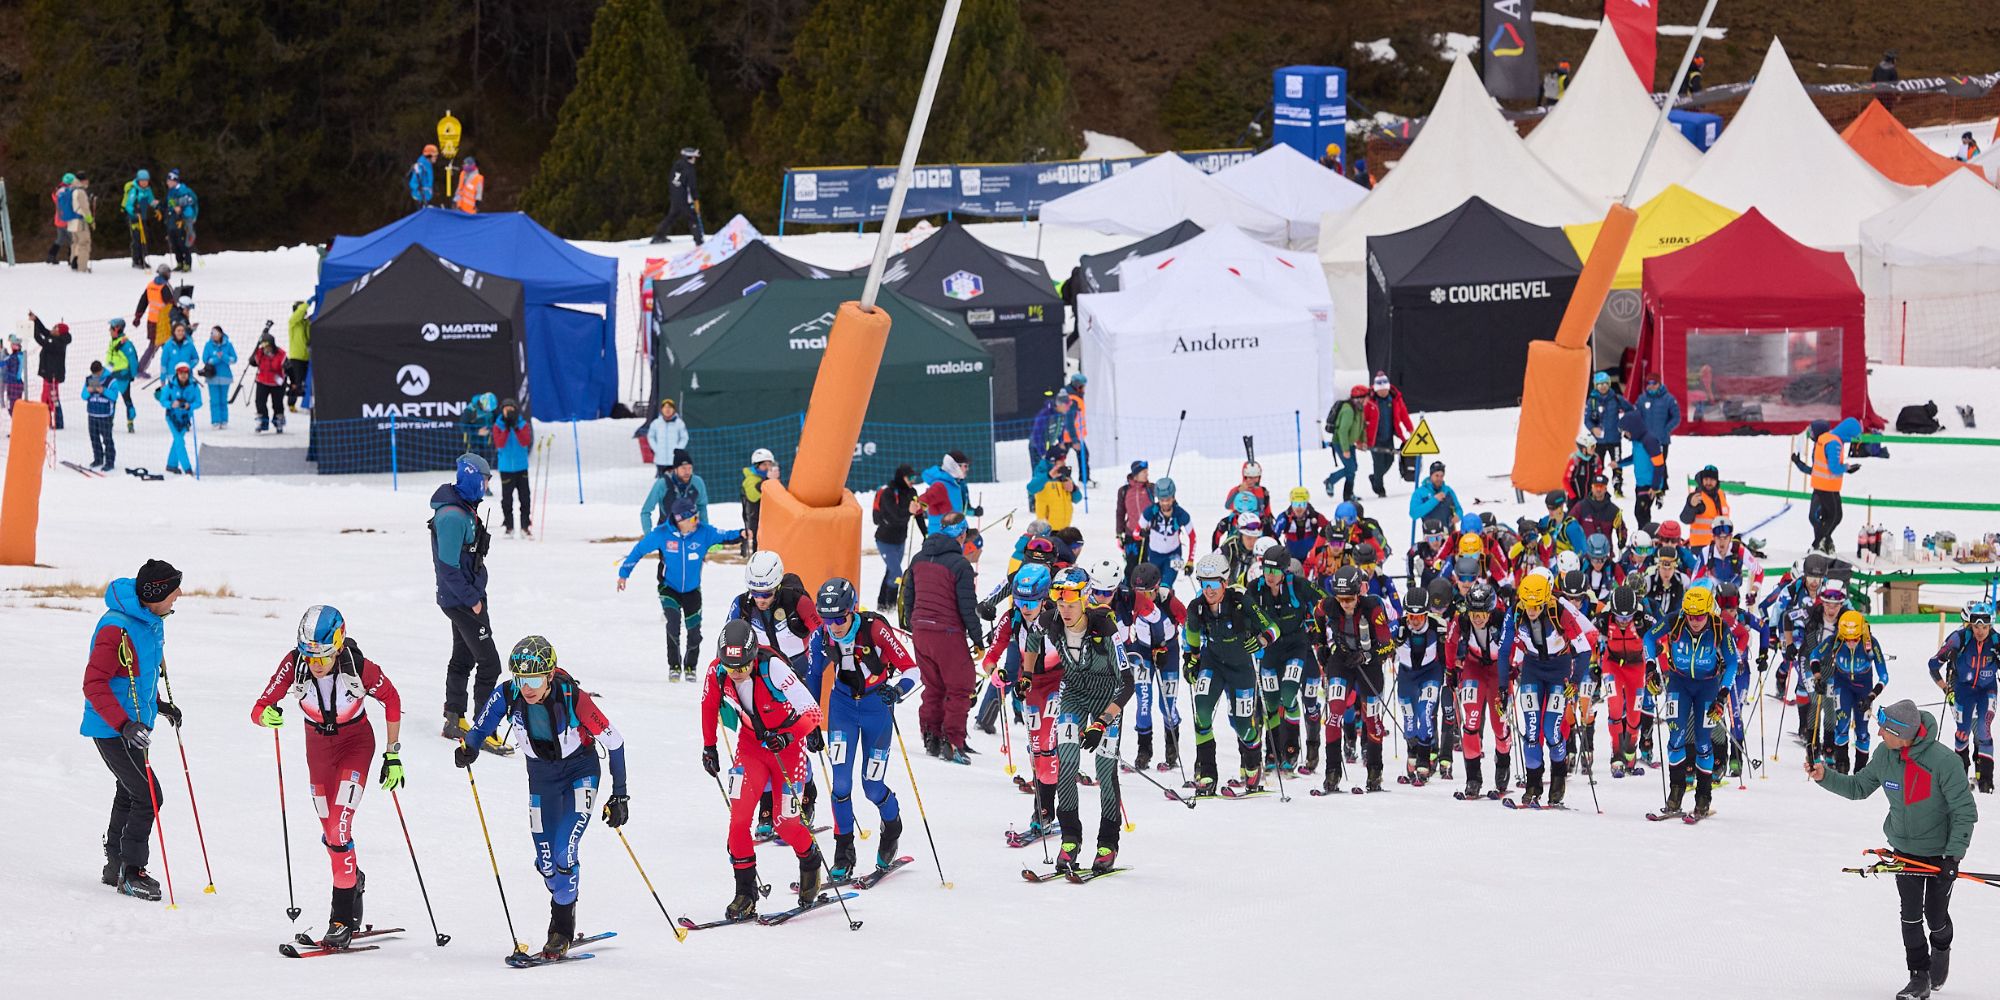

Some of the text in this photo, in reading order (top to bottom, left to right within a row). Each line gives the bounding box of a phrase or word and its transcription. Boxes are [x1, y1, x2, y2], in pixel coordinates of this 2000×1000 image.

[1658, 236, 1691, 245] SIDAS
[1449, 281, 1551, 304] COURCHEVEL
[441, 323, 498, 333] MARTINI
[789, 336, 827, 350] mal
[1172, 333, 1260, 354] Andorra
[926, 360, 973, 376] maloja
[362, 401, 467, 418] MARTINI
[377, 421, 453, 430] SPORTSWEAR
[726, 646, 741, 655] MF
[880, 627, 906, 659] FRANCE
[1288, 666, 1298, 679] 18
[780, 673, 797, 691] SUI
[1165, 681, 1176, 694] 27
[1264, 677, 1275, 690] 18
[1583, 684, 1593, 696] 19
[1140, 682, 1148, 716] FRANCE
[1332, 685, 1342, 697] 10
[1427, 687, 1433, 698] 8
[1463, 687, 1474, 701] 14
[1240, 701, 1252, 716] 15
[1526, 694, 1533, 709] 3
[1553, 695, 1560, 710] 3
[1468, 710, 1479, 729] SUI
[1065, 723, 1072, 740] 4
[1528, 711, 1537, 748] FRANE
[1032, 735, 1040, 752] SUI
[833, 743, 841, 761] 7
[872, 761, 880, 778] 7
[728, 775, 734, 795] 9
[348, 784, 356, 804] 1
[585, 789, 592, 810] 5
[790, 797, 798, 815] 9
